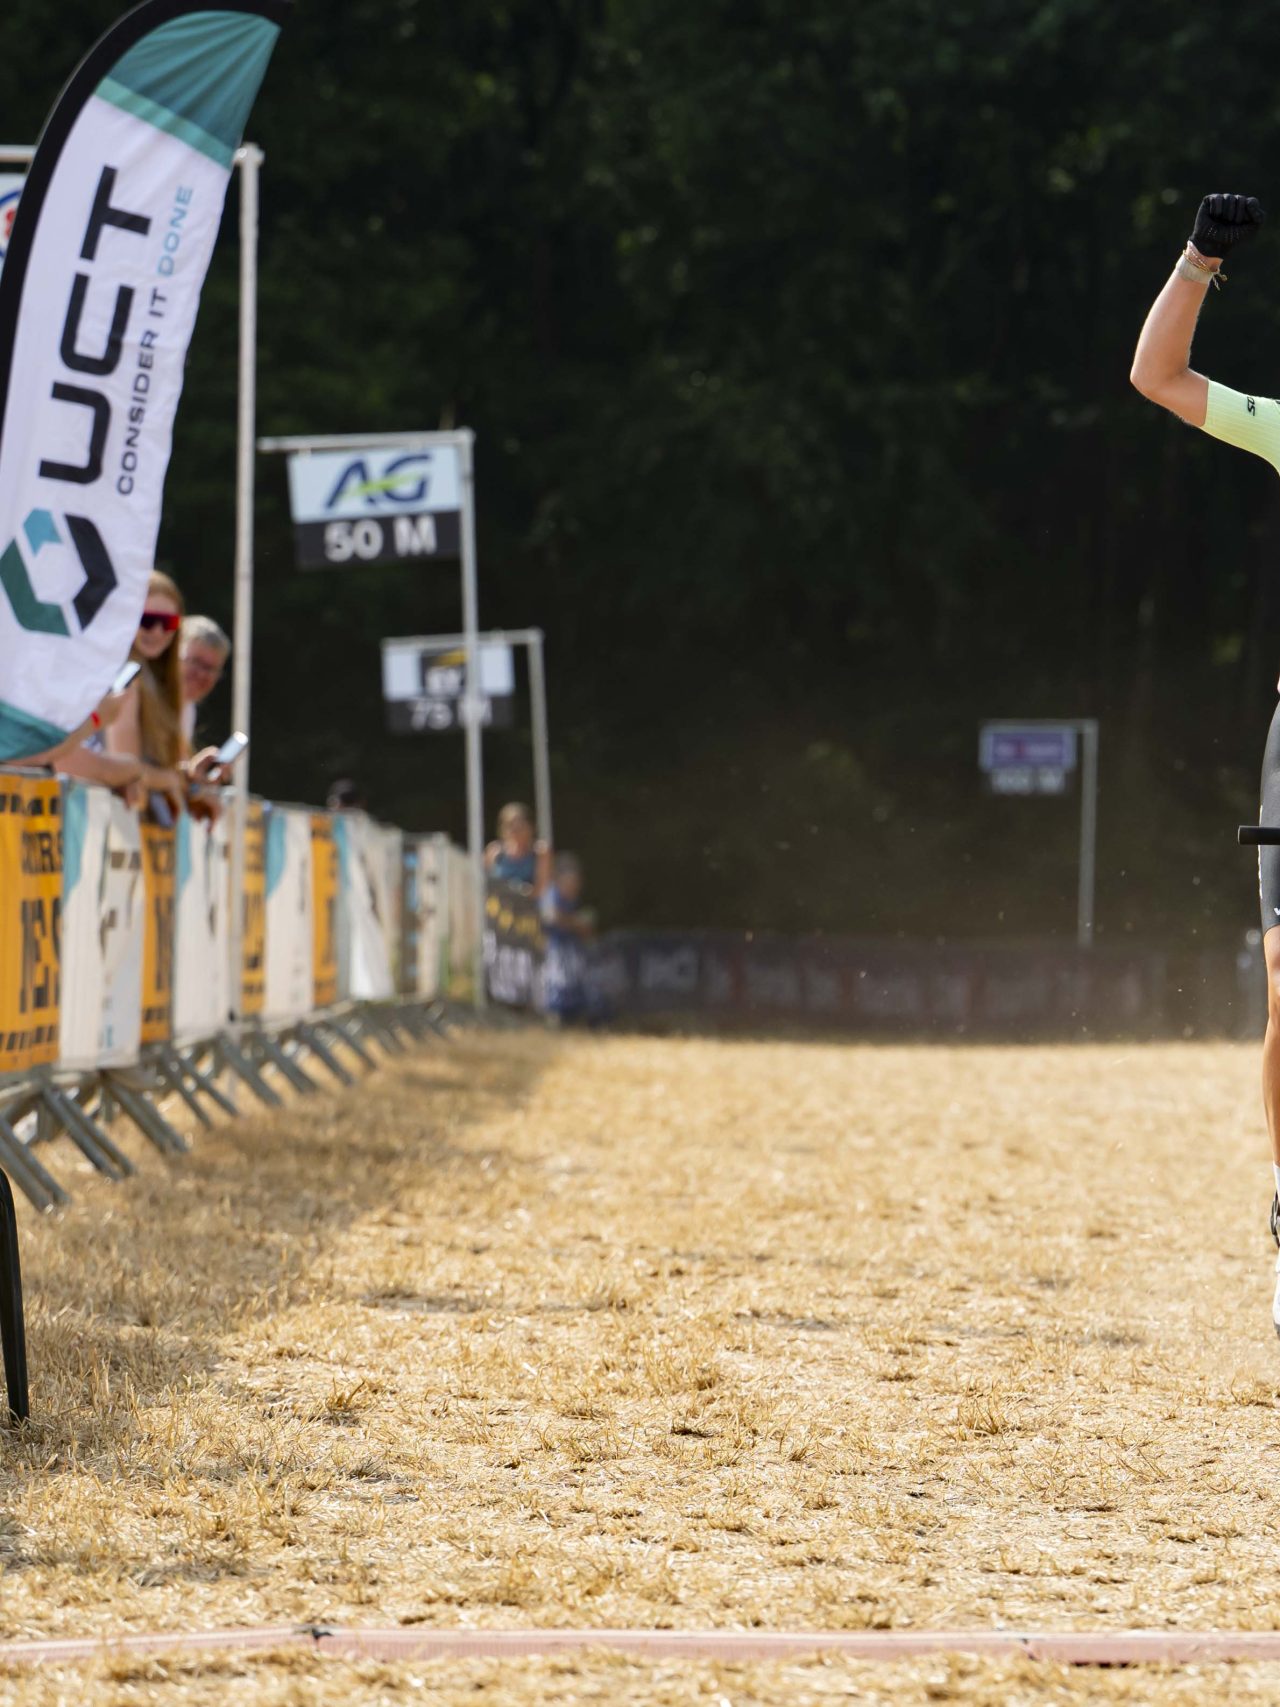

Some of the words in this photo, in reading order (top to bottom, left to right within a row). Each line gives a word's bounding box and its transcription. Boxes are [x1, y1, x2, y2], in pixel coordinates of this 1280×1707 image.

[157, 185, 194, 278] DONE
[38, 165, 152, 485] UCT
[148, 287, 168, 319] IT
[116, 329, 160, 496] CONSIDER
[325, 453, 432, 510] AG
[325, 519, 384, 562] 50
[393, 513, 438, 557] M
